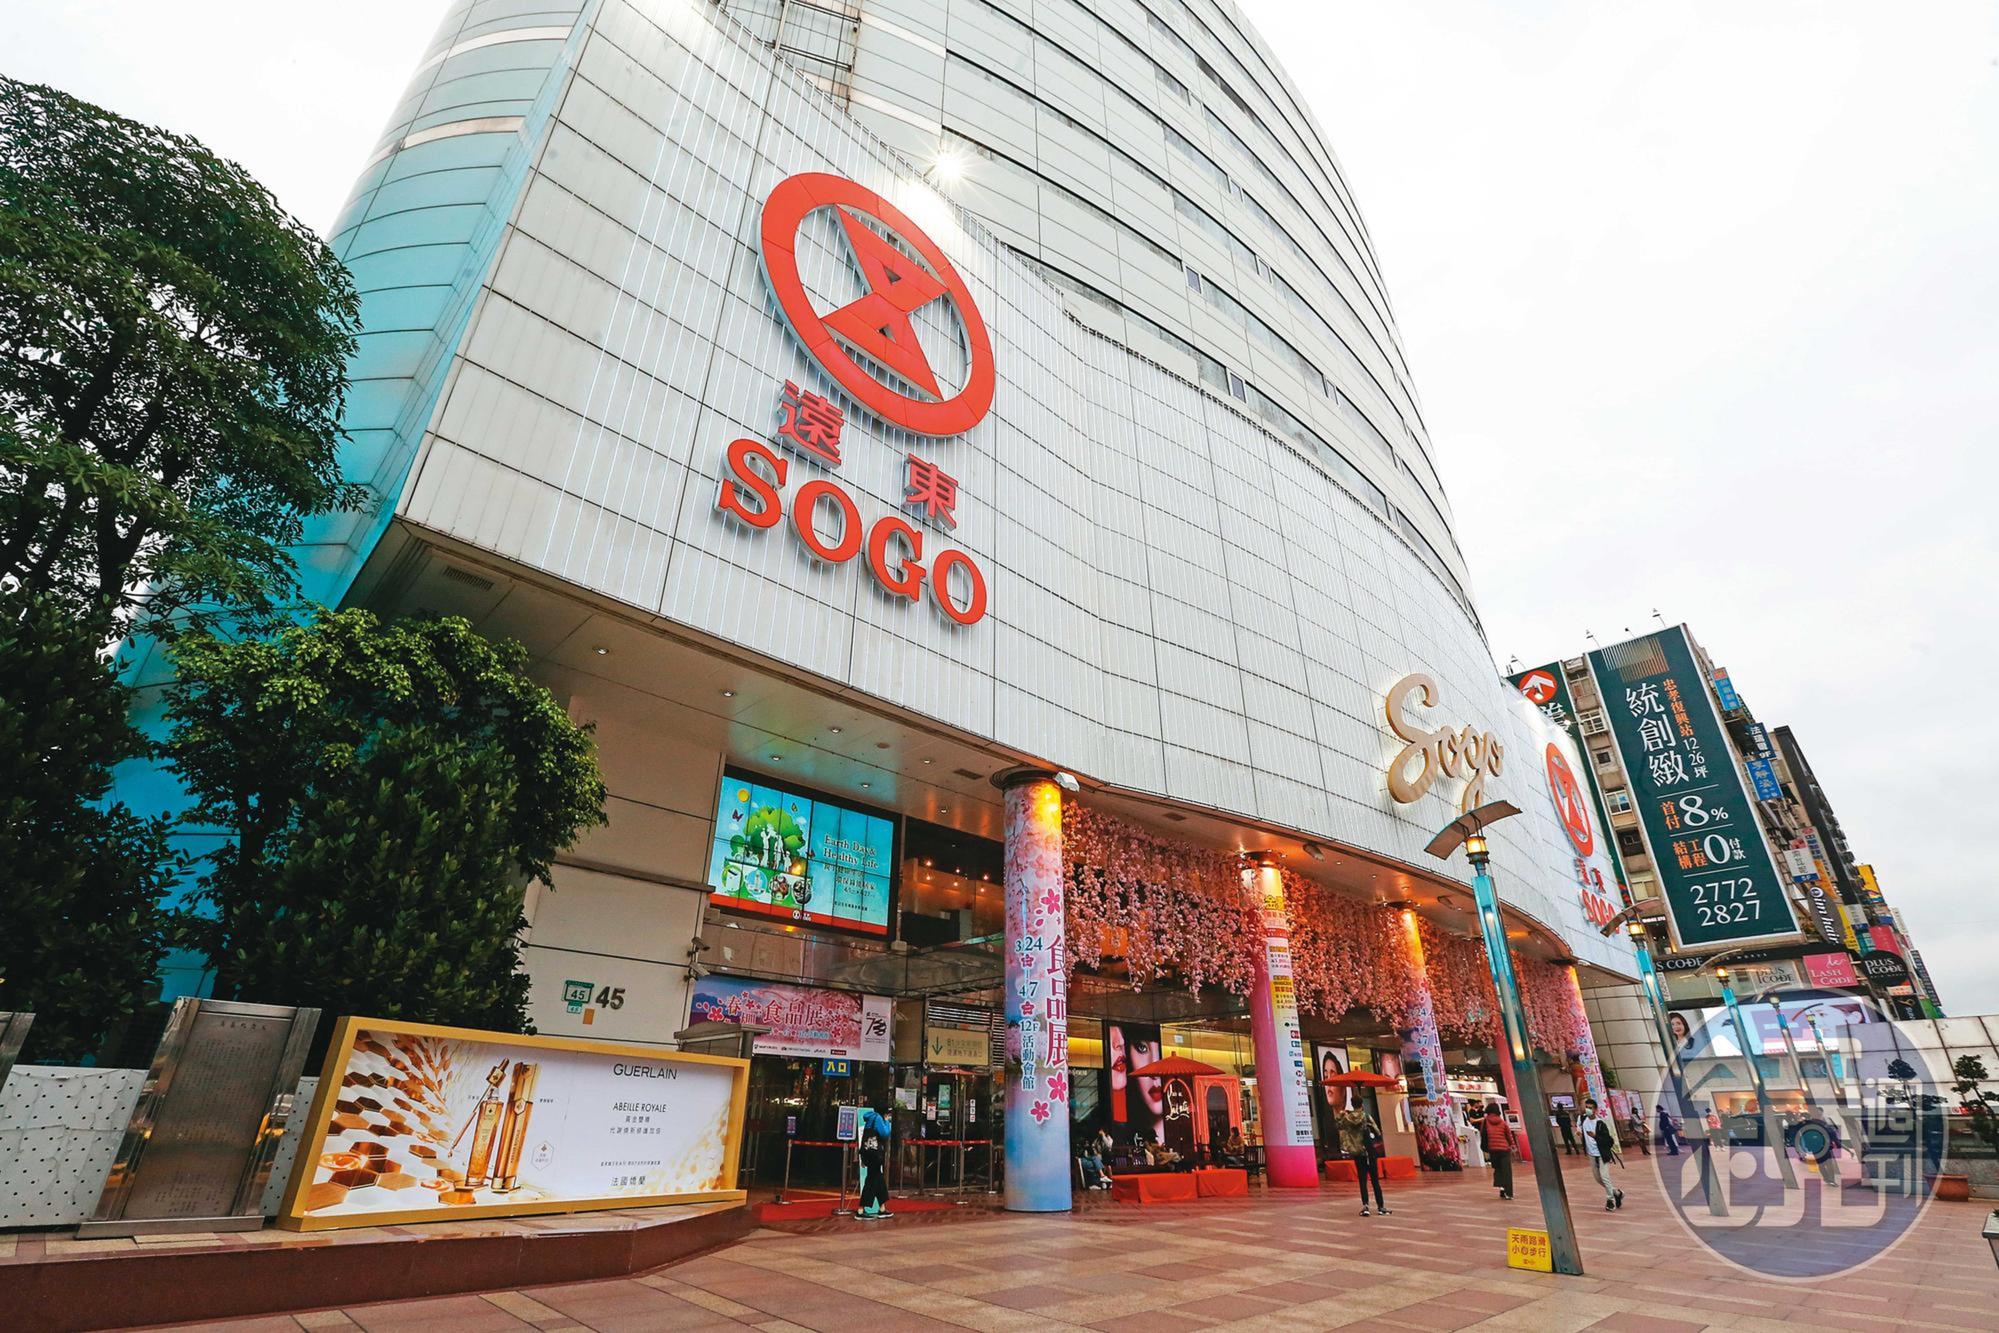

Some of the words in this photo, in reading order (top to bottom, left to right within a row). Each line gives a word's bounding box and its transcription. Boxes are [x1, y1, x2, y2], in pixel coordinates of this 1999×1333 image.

[714, 438, 987, 626] SOGO
[1662, 678, 1695, 737] 忠孝復興站
[1386, 673, 1505, 814] Sogo
[1625, 682, 1690, 788] 統創緻
[1660, 800, 1681, 831] 首付
[1679, 795, 1729, 827] 8%
[824, 834, 850, 849] Earth
[1703, 834, 1731, 865] 0
[1729, 837, 1747, 862] 付款
[823, 847, 858, 865] Healthy
[1689, 877, 1757, 905] 2772
[1697, 900, 1761, 927] 2827
[1820, 915, 1841, 945] hair
[1809, 968, 1842, 977] LASH
[1864, 959, 1895, 975] PLUS
[1820, 976, 1855, 985] CODE
[570, 989, 585, 1000] 45
[595, 986, 626, 1010] 45
[1045, 934, 1068, 1068] 食品展
[763, 998, 824, 1028] 食品展
[612, 1063, 678, 1080] GUERLAIN
[826, 1061, 847, 1073] 入口
[1022, 1034, 1035, 1090] 活動會館
[612, 1102, 640, 1112] ABEILLE
[641, 1103, 667, 1113] ROYALE
[1511, 1233, 1546, 1247] 天雨路滑
[1511, 1244, 1547, 1258] 小心步行
